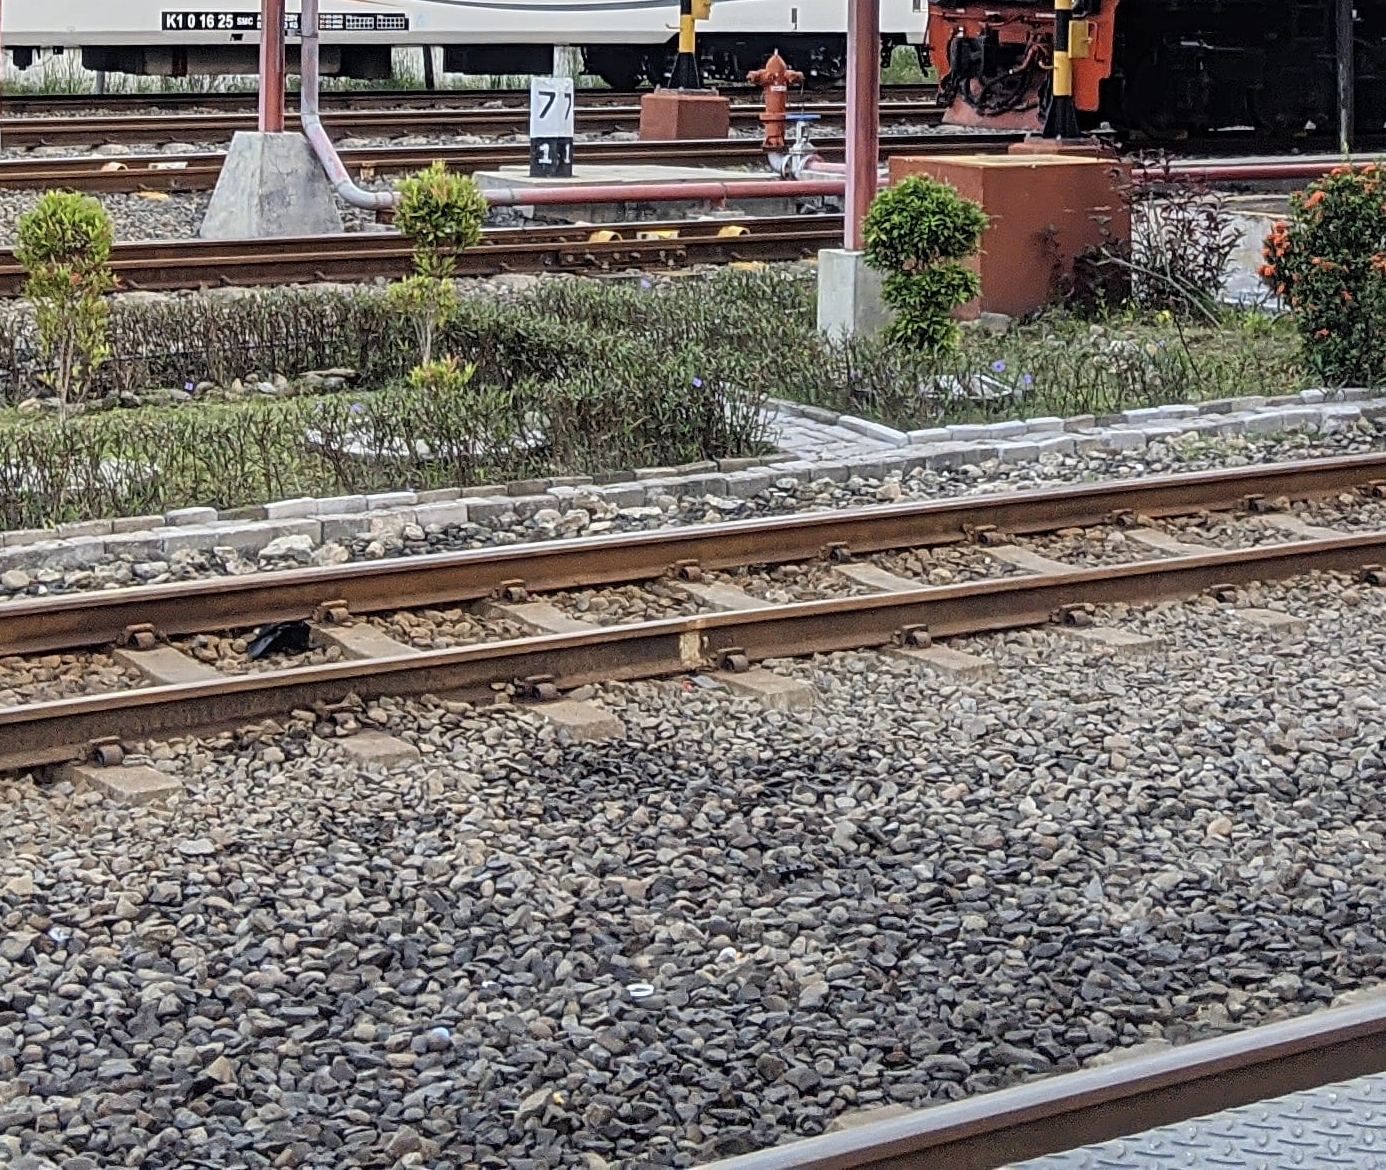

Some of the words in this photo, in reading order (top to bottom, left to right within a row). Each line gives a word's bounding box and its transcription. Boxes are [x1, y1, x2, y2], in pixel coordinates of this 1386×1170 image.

[166, 13, 183, 29] K1
[187, 13, 196, 29] 0
[199, 13, 214, 29] 16
[217, 13, 234, 29] 25
[538, 91, 556, 119] 7
[538, 142, 553, 165] 1
